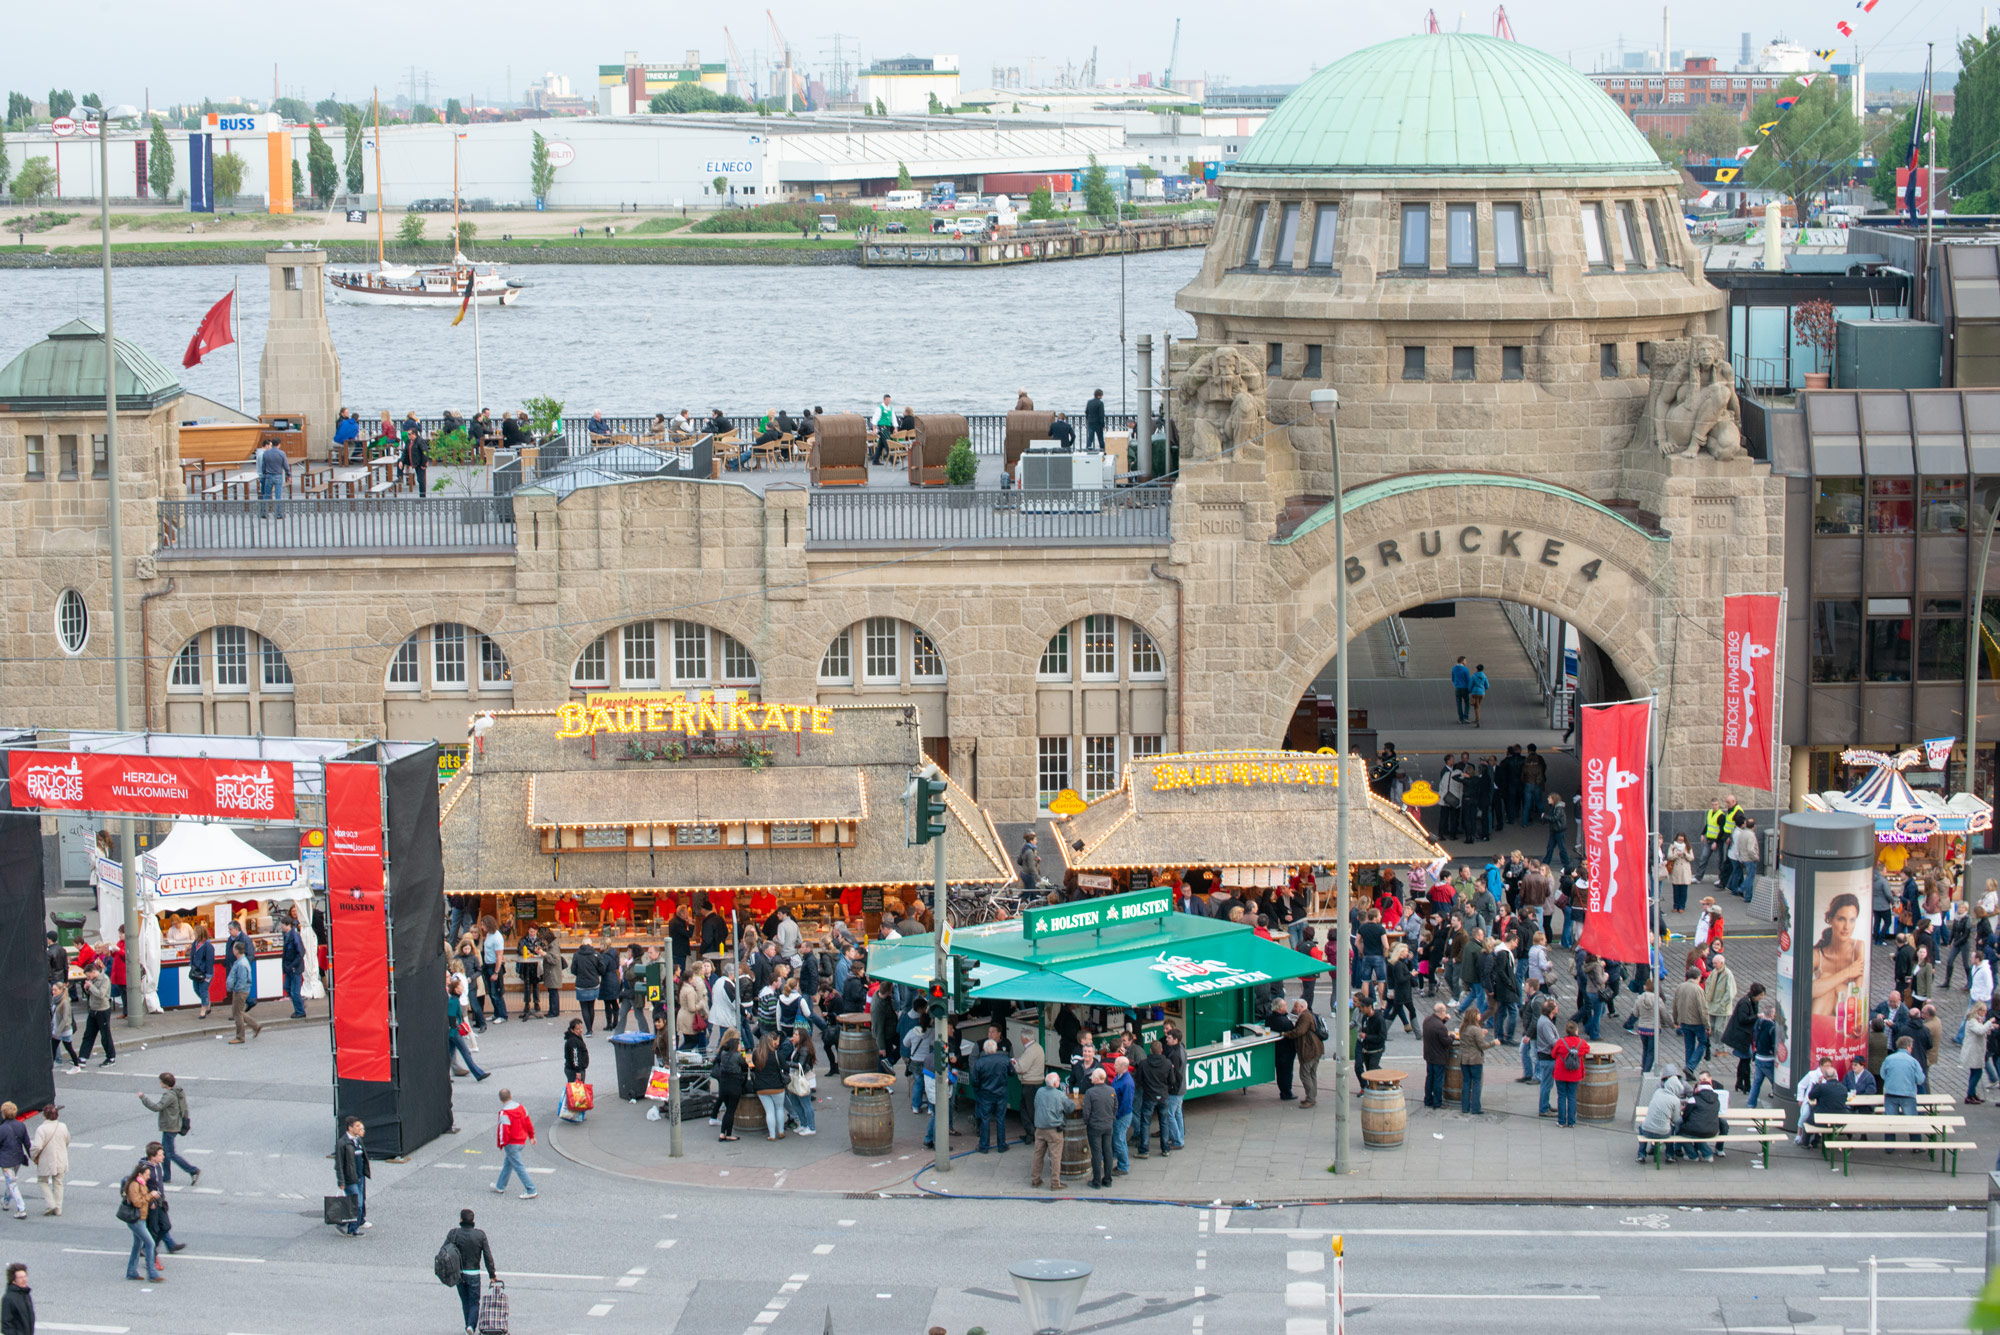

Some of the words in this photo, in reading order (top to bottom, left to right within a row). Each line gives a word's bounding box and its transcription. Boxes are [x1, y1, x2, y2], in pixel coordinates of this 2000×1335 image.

[669, 71, 679, 80] AG
[220, 118, 254, 131] BUSS
[706, 161, 752, 173] ELNECO
[1200, 519, 1241, 535] NORD
[1580, 558, 1602, 582] 4
[555, 701, 834, 740] BAUERNKATE
[27, 772, 83, 791] BRÜCKE
[122, 771, 177, 785] HERZLICH
[28, 787, 84, 802] HAMBURG
[112, 785, 189, 800] WILLKOMMEN!
[216, 781, 274, 799] BRÜCKE
[216, 796, 274, 811] HAMBURG
[160, 874, 214, 893] Crêpes
[220, 871, 235, 886] de
[238, 868, 292, 888] France
[339, 902, 375, 912] HOLSTEN
[1051, 911, 1099, 932] HOLSTEN
[1122, 898, 1169, 919] HOLSTEN
[1176, 970, 1272, 994] HOLSTEN
